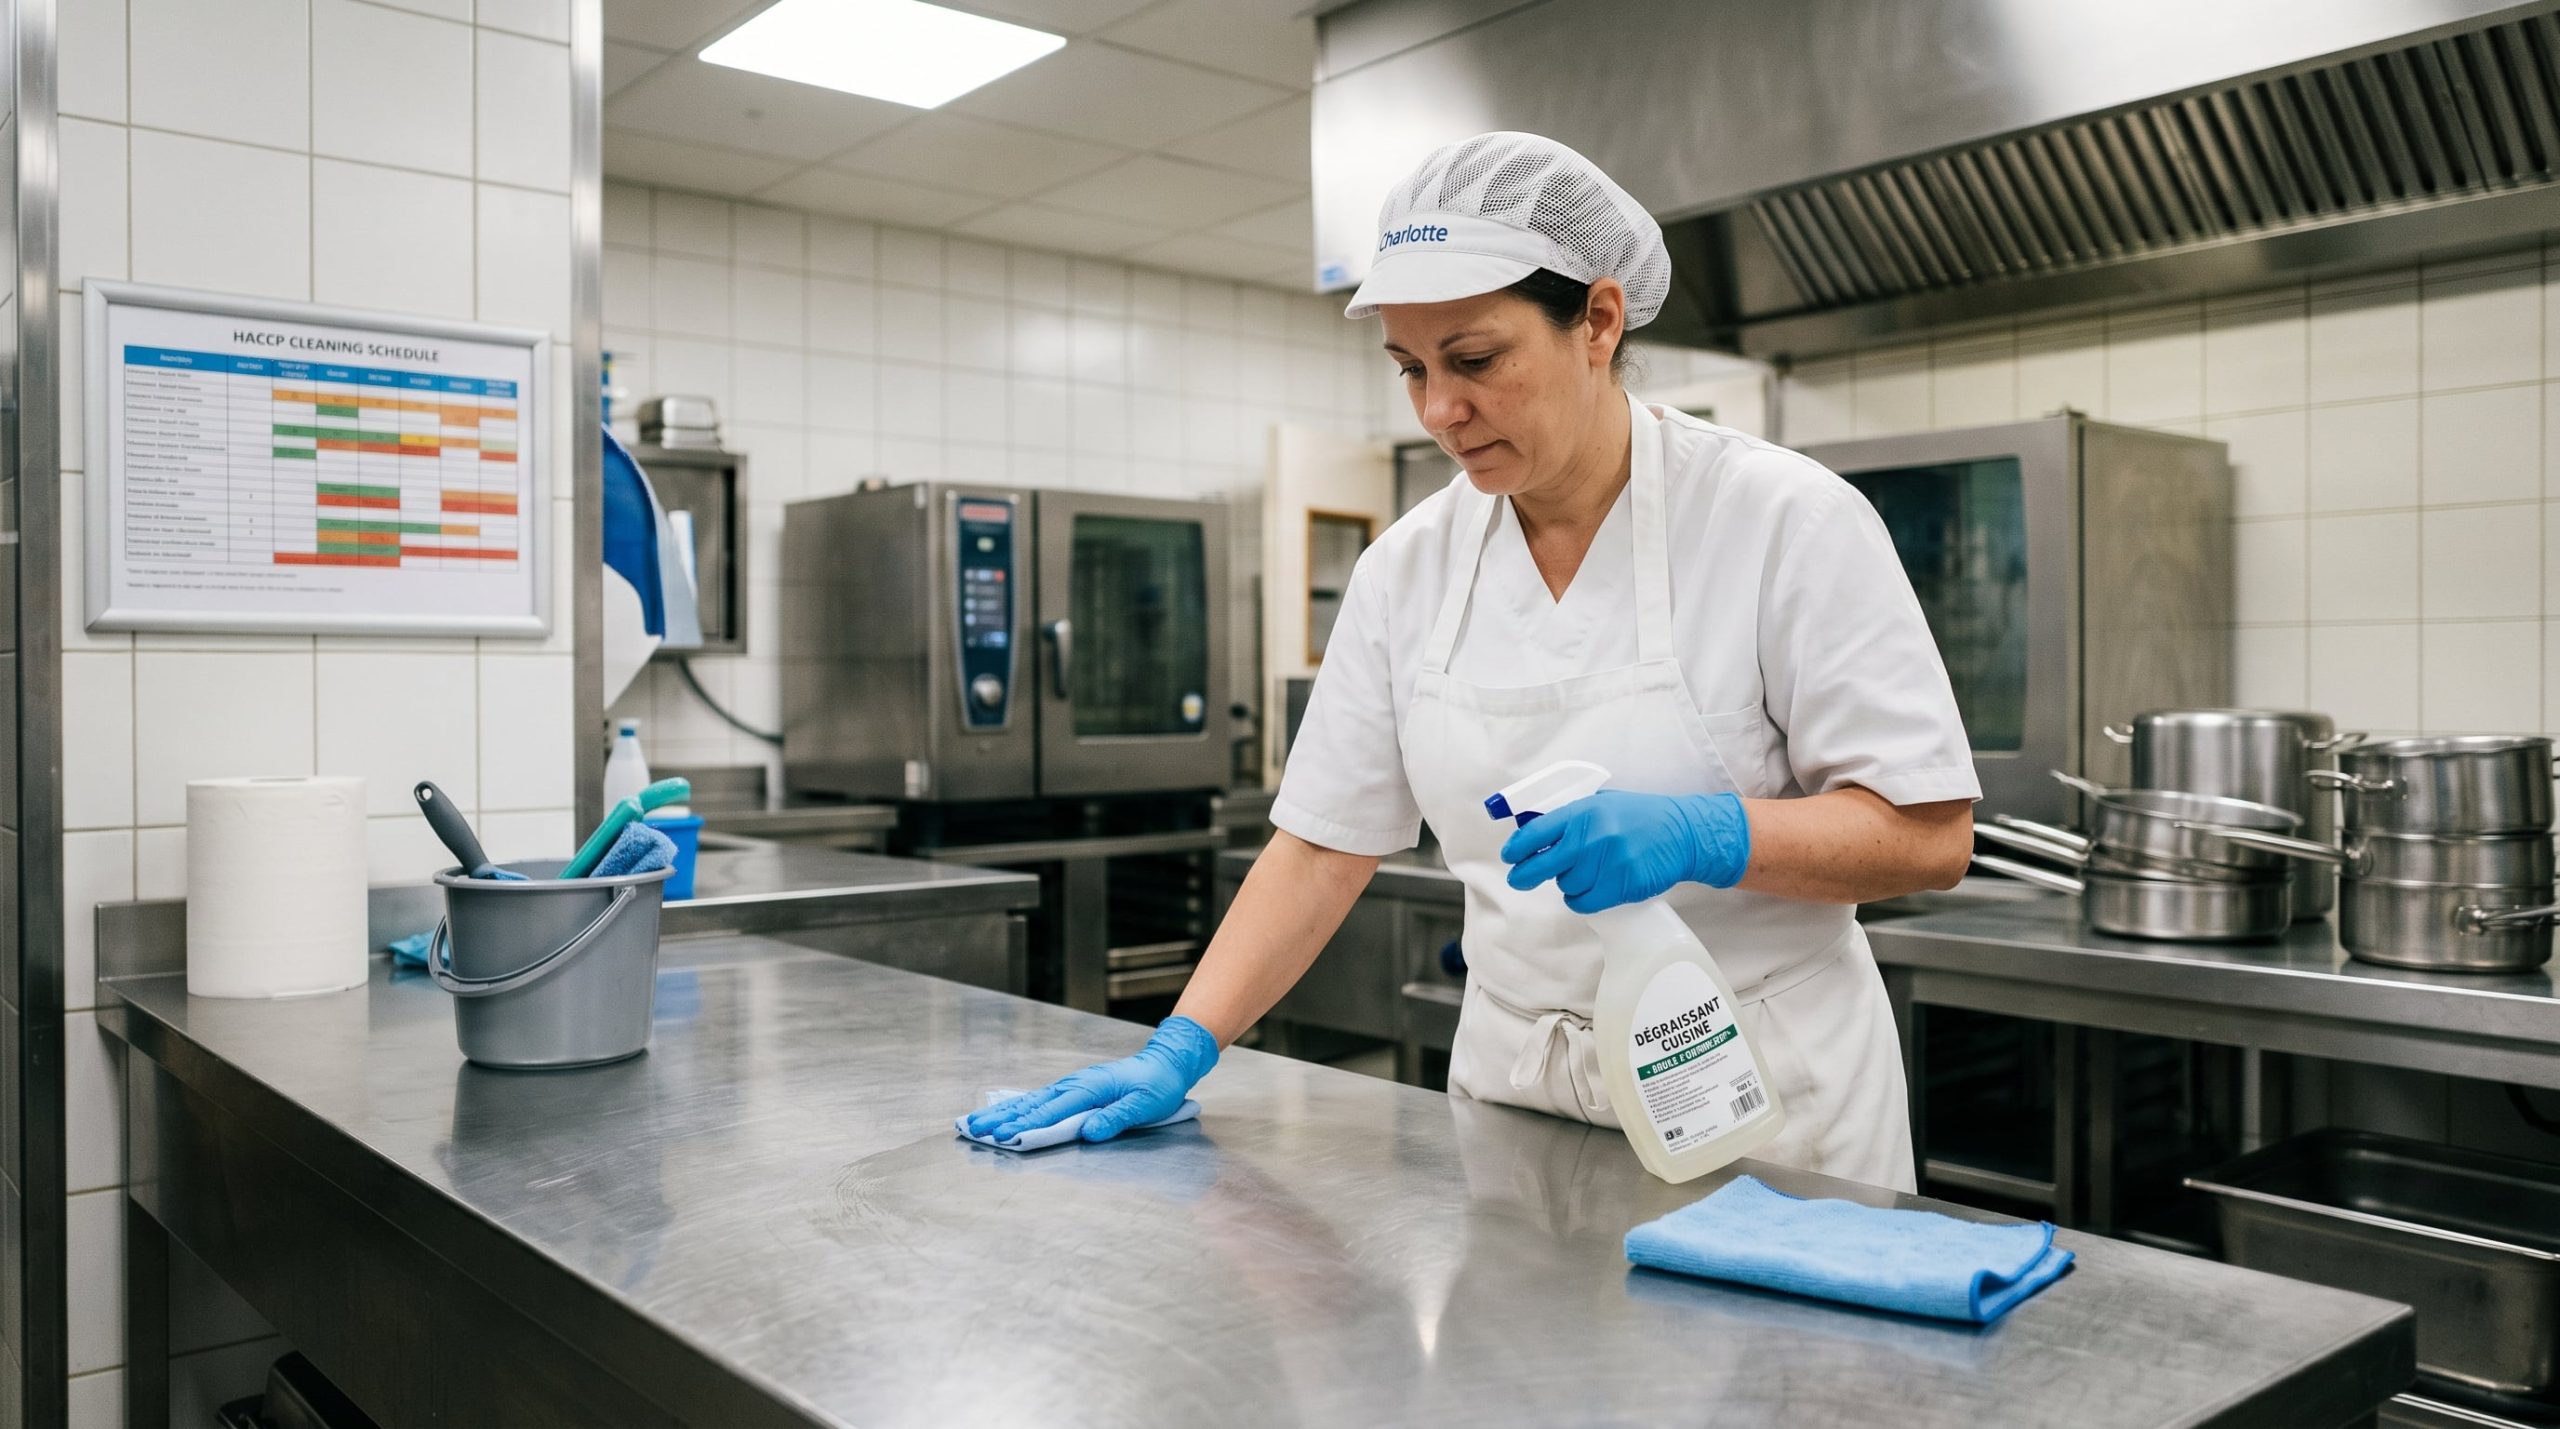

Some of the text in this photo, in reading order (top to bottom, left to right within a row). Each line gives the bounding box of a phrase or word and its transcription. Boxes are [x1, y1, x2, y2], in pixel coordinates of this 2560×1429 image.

[1379, 224, 1448, 252] Charlotte
[233, 329, 440, 363] HACCP CLEANING SCHEDULE
[1635, 996, 1721, 1047] DÉGRAISSANT
[1661, 1020, 1713, 1052] CUISINE
